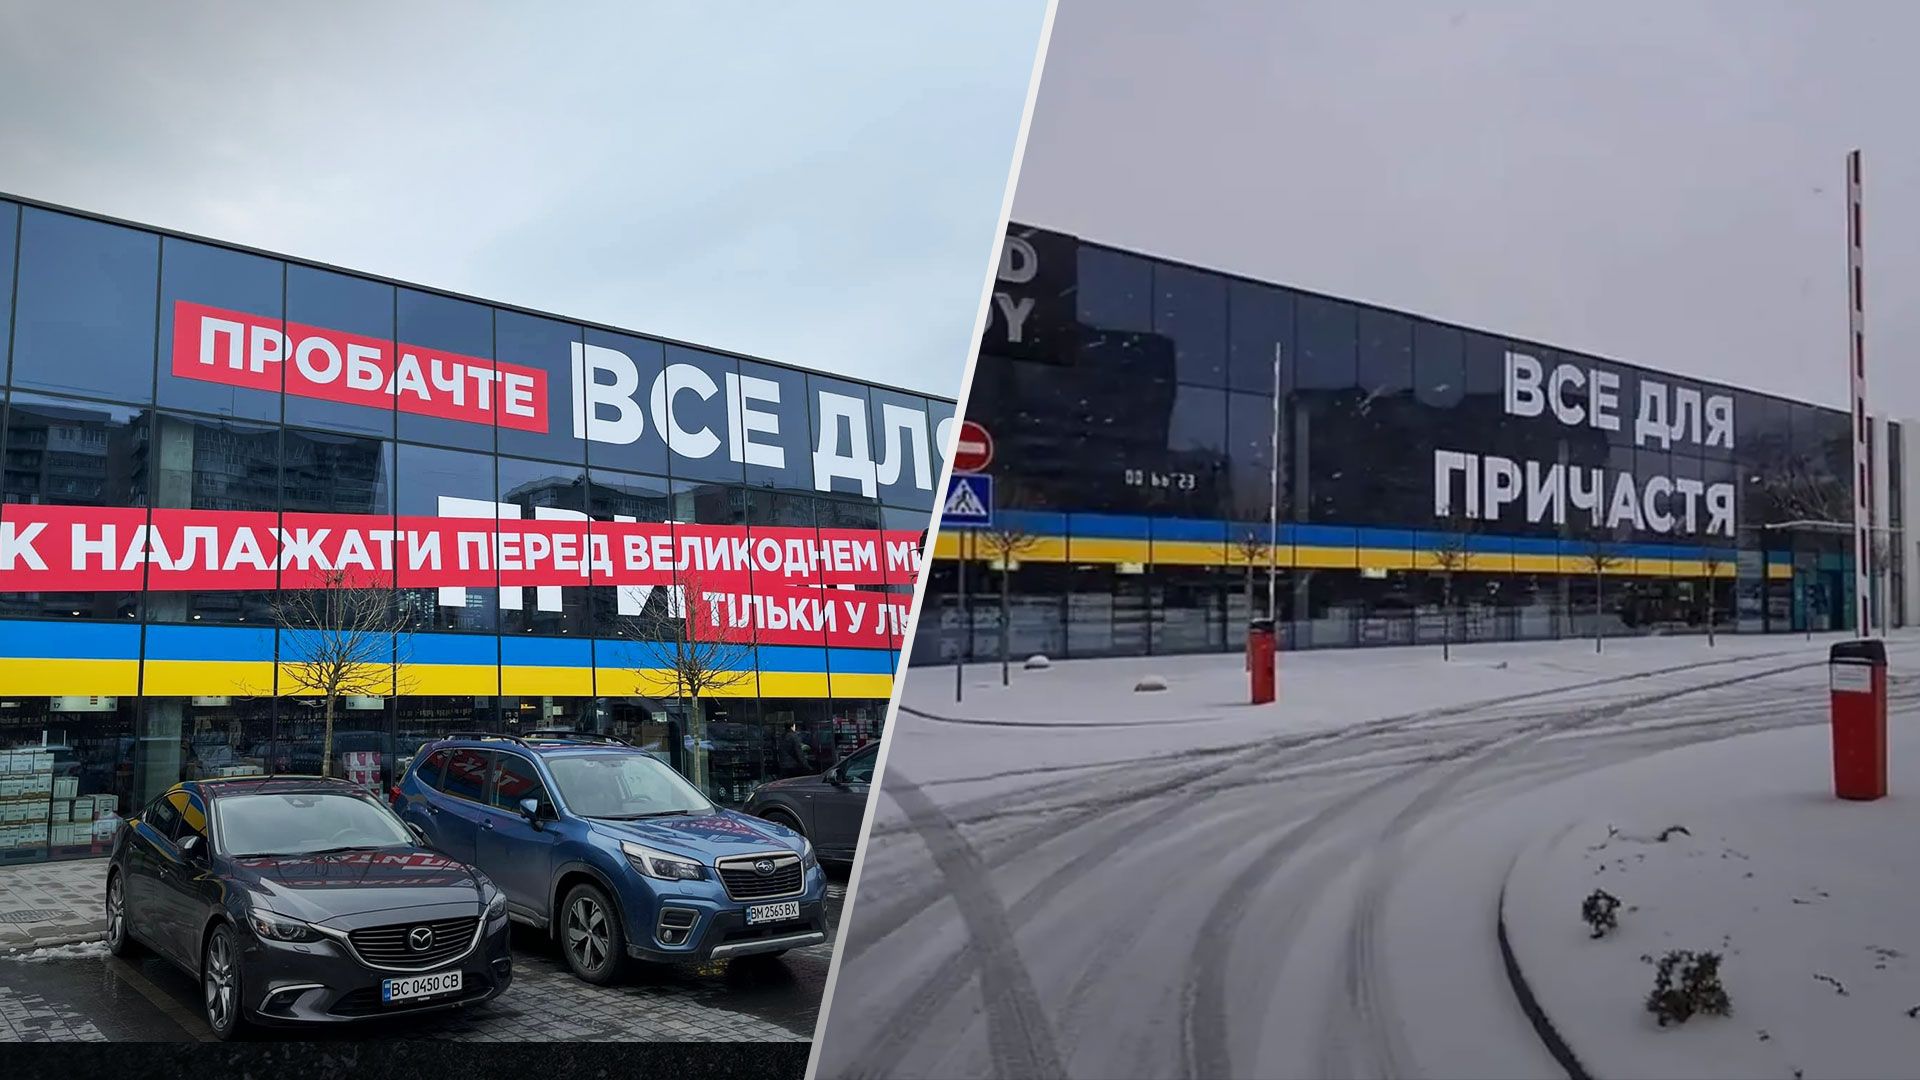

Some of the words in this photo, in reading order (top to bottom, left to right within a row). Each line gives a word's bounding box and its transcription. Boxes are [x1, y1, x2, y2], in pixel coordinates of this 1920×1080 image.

[199, 315, 536, 418] ПРОБАЧТЕ
[1504, 351, 1621, 431] ВСЕ
[1635, 379, 1736, 450] ДЛЯ
[569, 341, 786, 470] ВСЕ
[1433, 449, 1736, 538] ПРИЧАСТЯ
[0, 521, 49, 571] К
[71, 523, 442, 571] НАЛАЖАТИ
[457, 531, 614, 578] ПЕРЕД
[623, 534, 878, 578] ВЕЛИКОДНЕМ
[702, 592, 836, 634] ТІЛЬКИ
[847, 601, 867, 635] У
[751, 907, 764, 920] BM
[764, 905, 784, 918] 2565
[785, 903, 797, 916] BX
[392, 981, 409, 997] BC
[412, 976, 440, 994] 0450
[442, 974, 459, 989] CB
